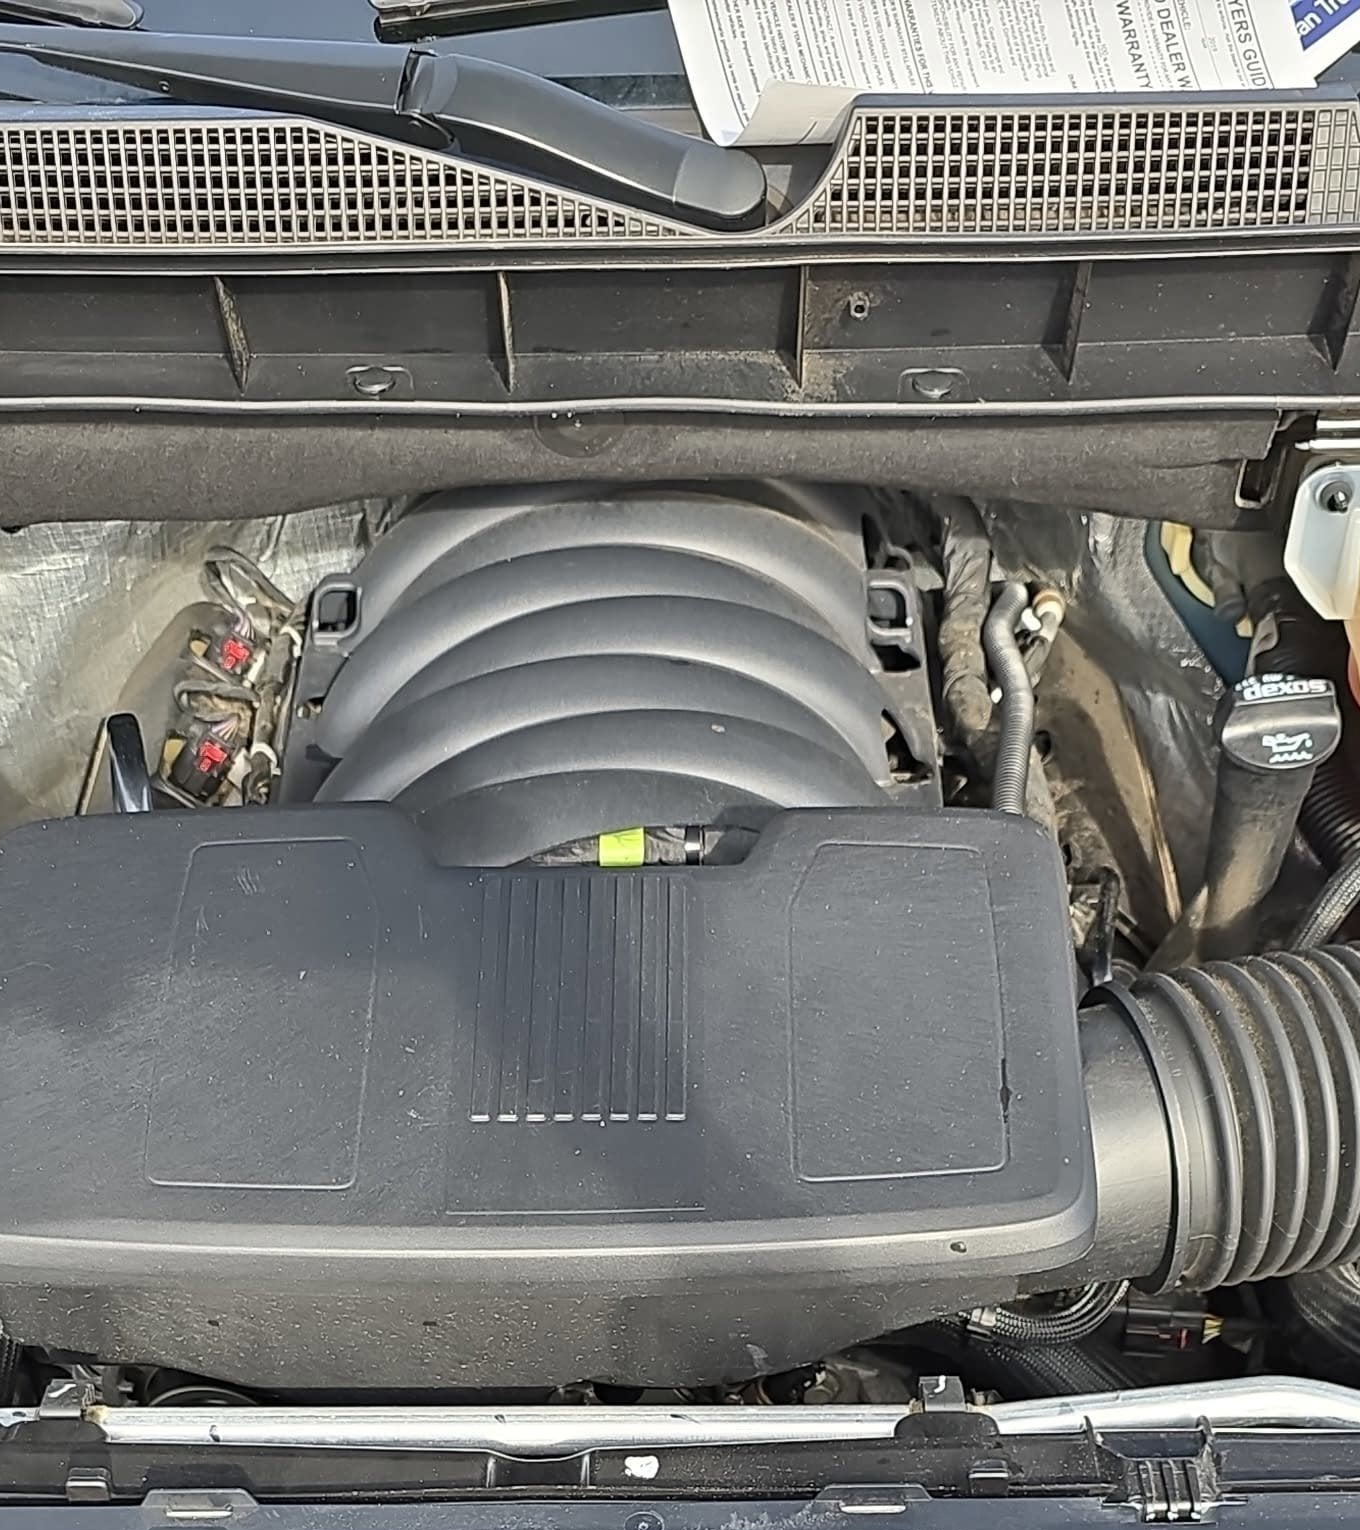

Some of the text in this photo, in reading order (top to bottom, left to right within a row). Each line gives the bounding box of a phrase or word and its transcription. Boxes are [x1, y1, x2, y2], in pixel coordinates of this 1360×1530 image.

[1114, 0, 1152, 92] WARRANTY
[1156, 7, 1186, 73] DEALER
[1243, 680, 1327, 700] dexos
